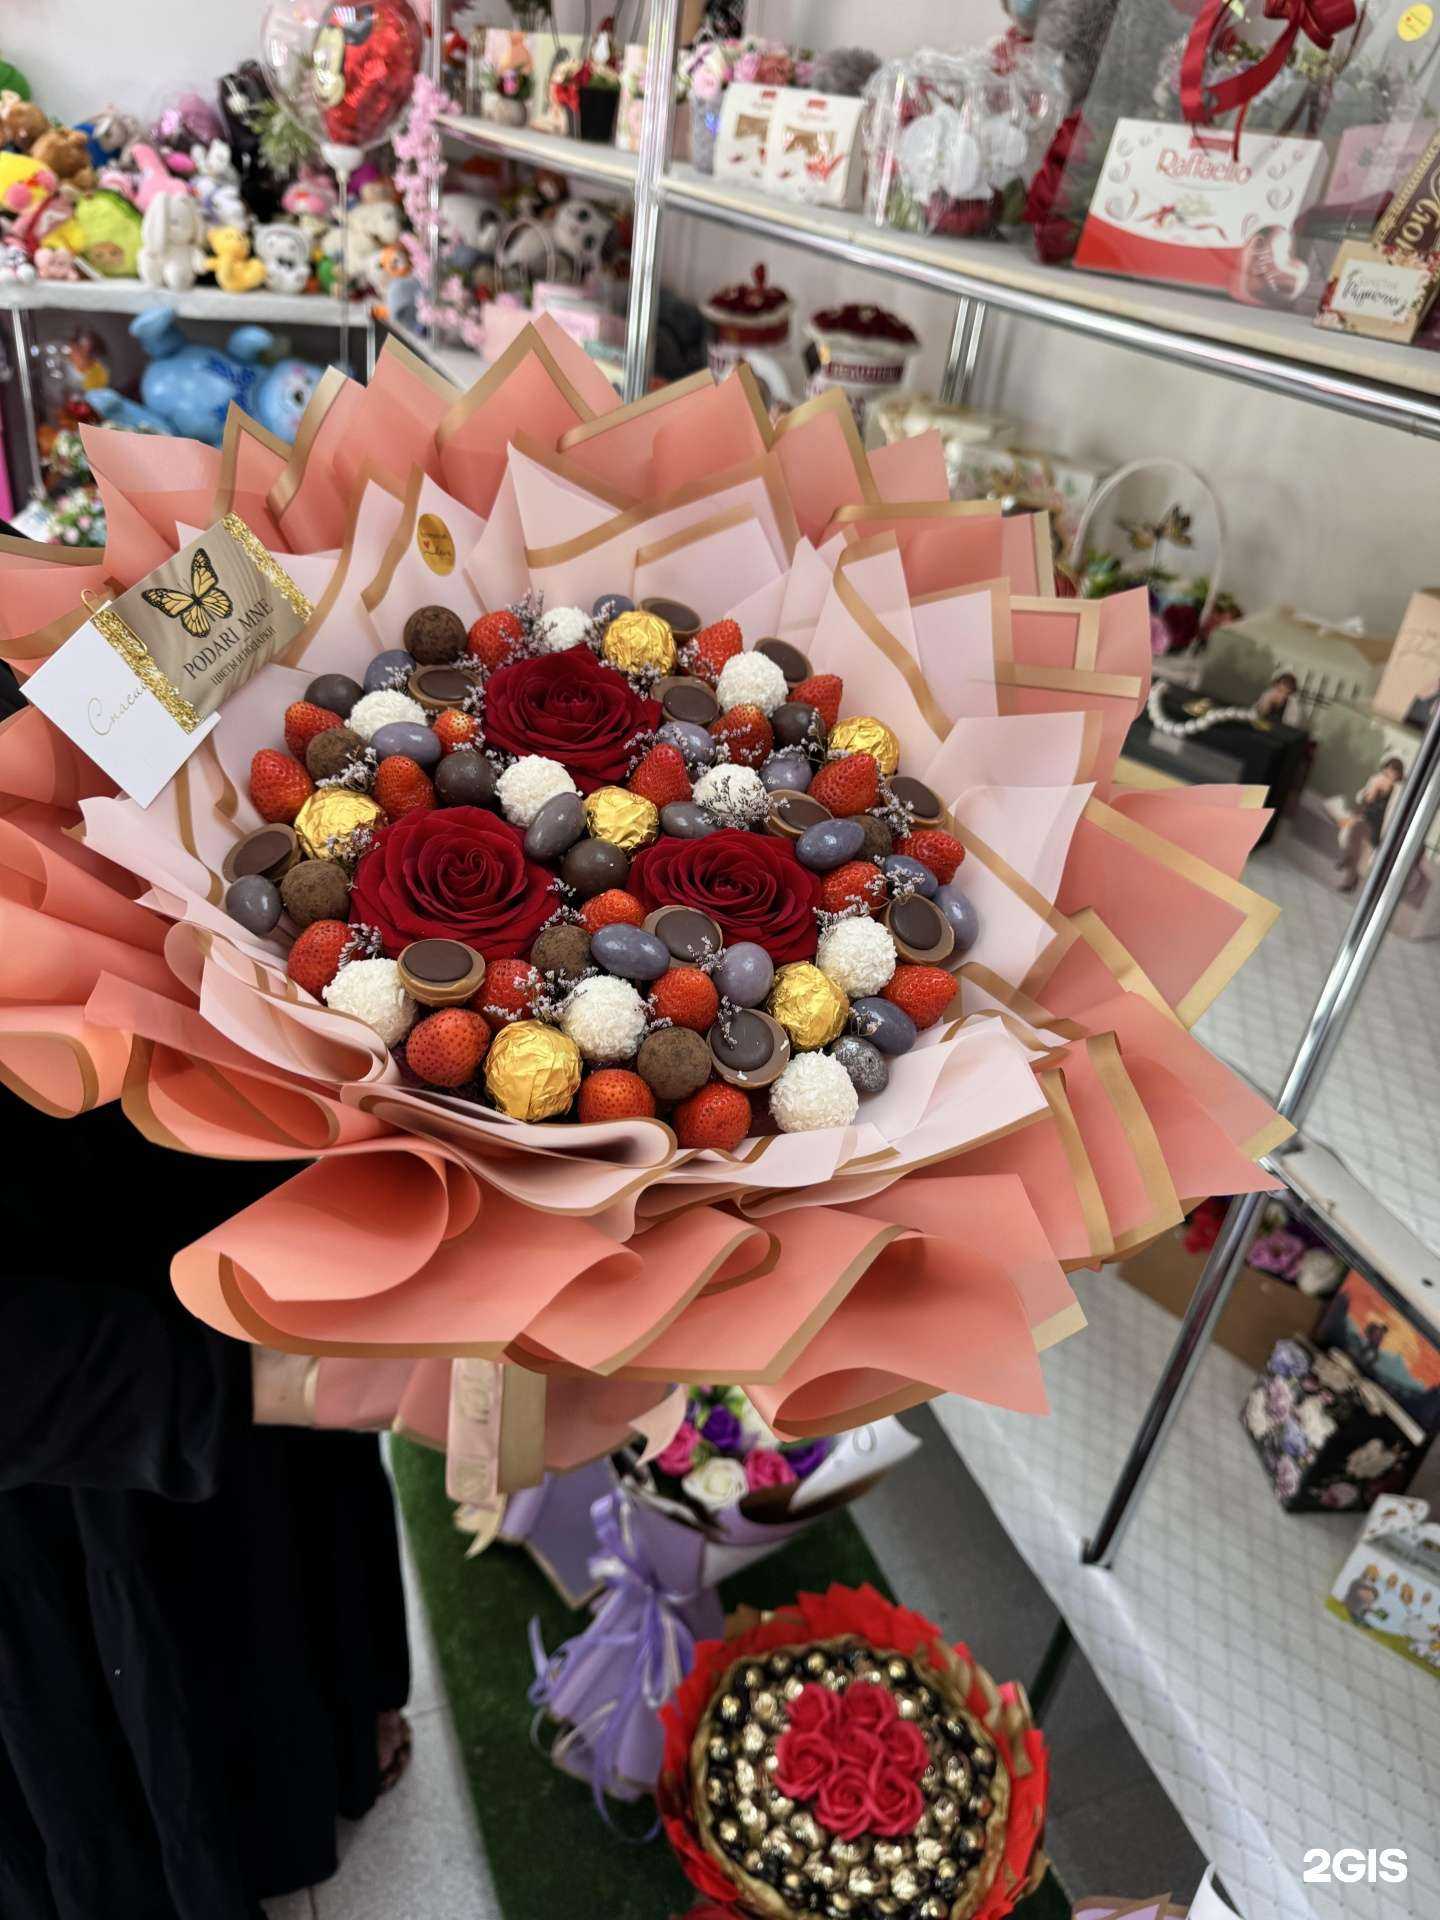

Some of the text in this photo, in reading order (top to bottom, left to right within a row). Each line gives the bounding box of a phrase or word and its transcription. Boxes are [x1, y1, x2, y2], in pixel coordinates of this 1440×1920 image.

[1156, 148, 1252, 185] Raffaello
[183, 598, 274, 680] PODARI MNE
[209, 657, 238, 687] ЦВЕТЫ
